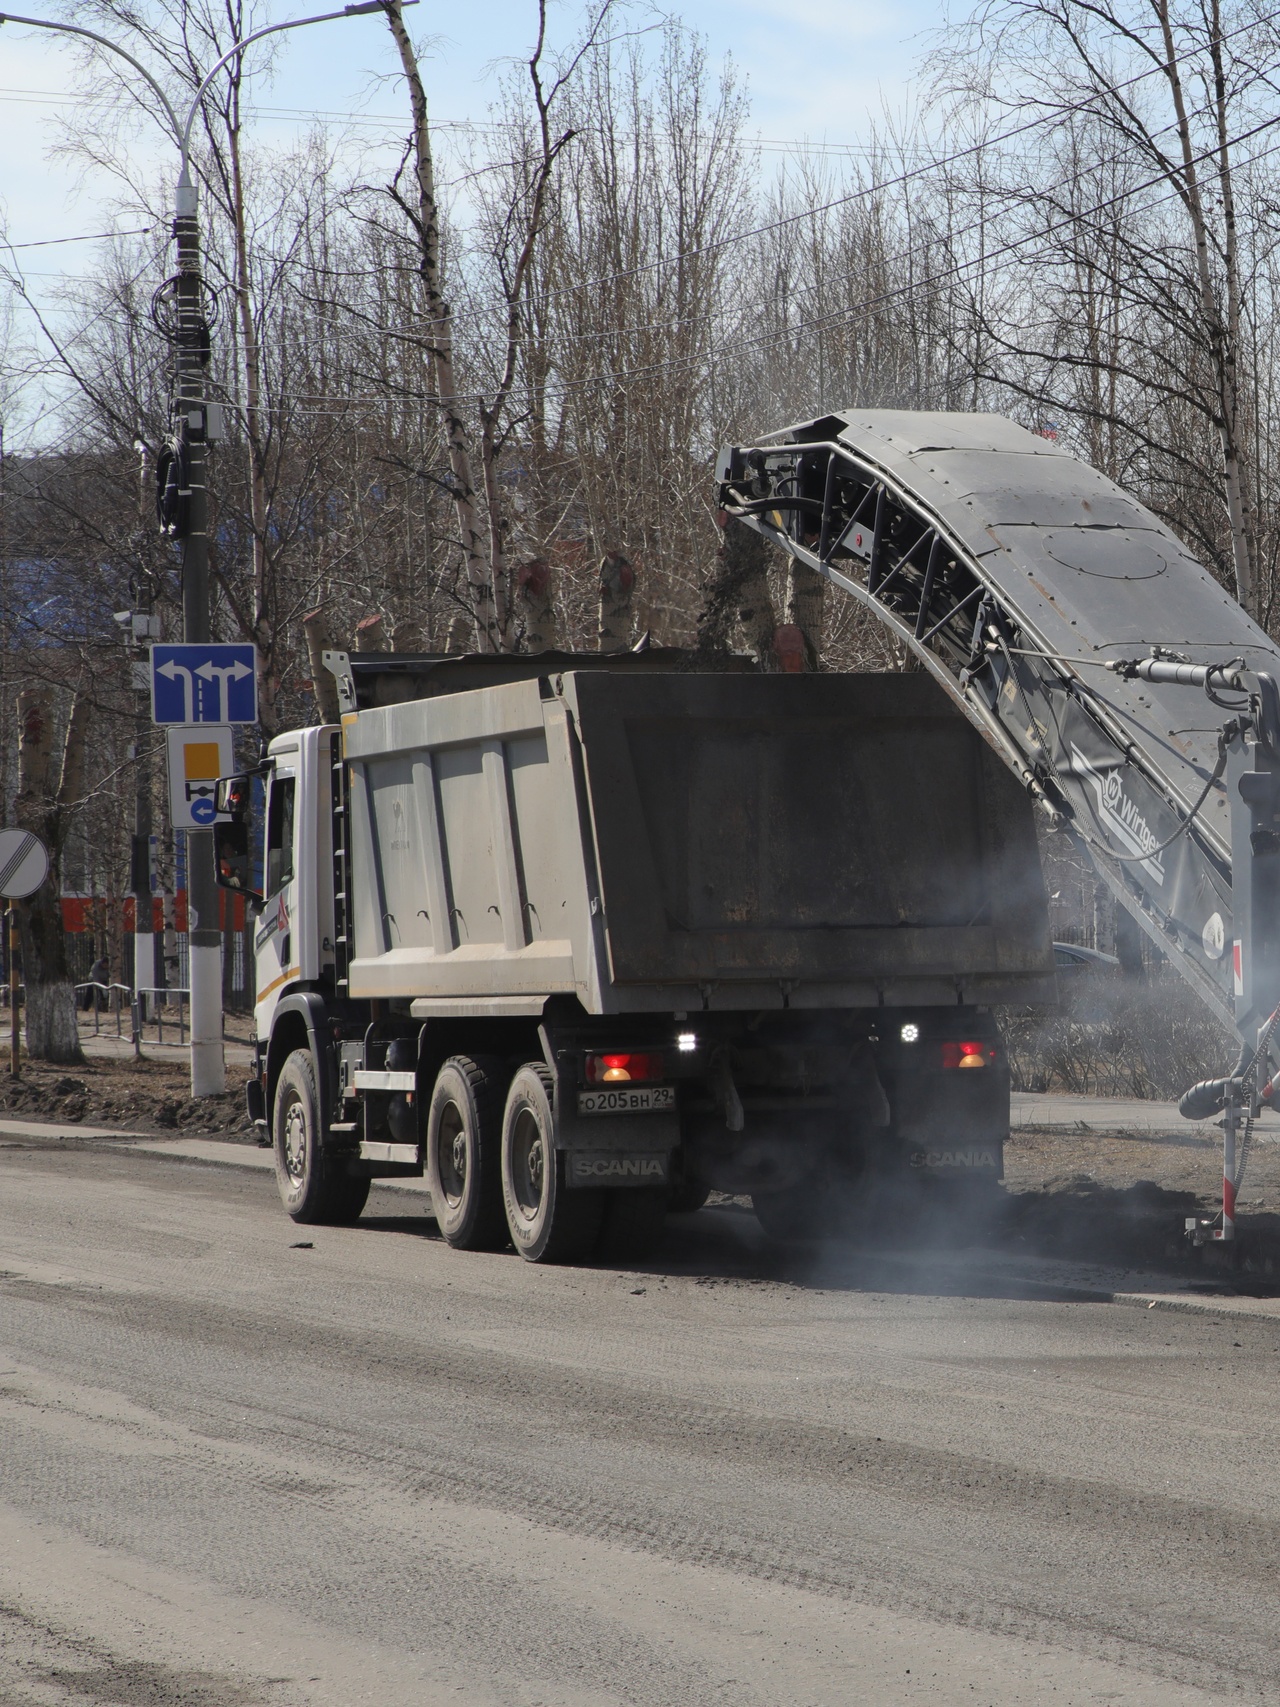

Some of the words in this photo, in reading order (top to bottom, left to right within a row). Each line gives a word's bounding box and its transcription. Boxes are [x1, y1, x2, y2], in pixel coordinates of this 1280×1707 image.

[653, 1089, 669, 1102] 29
[575, 1159, 664, 1176] SCANIA
[909, 1151, 996, 1168] SCANIA
